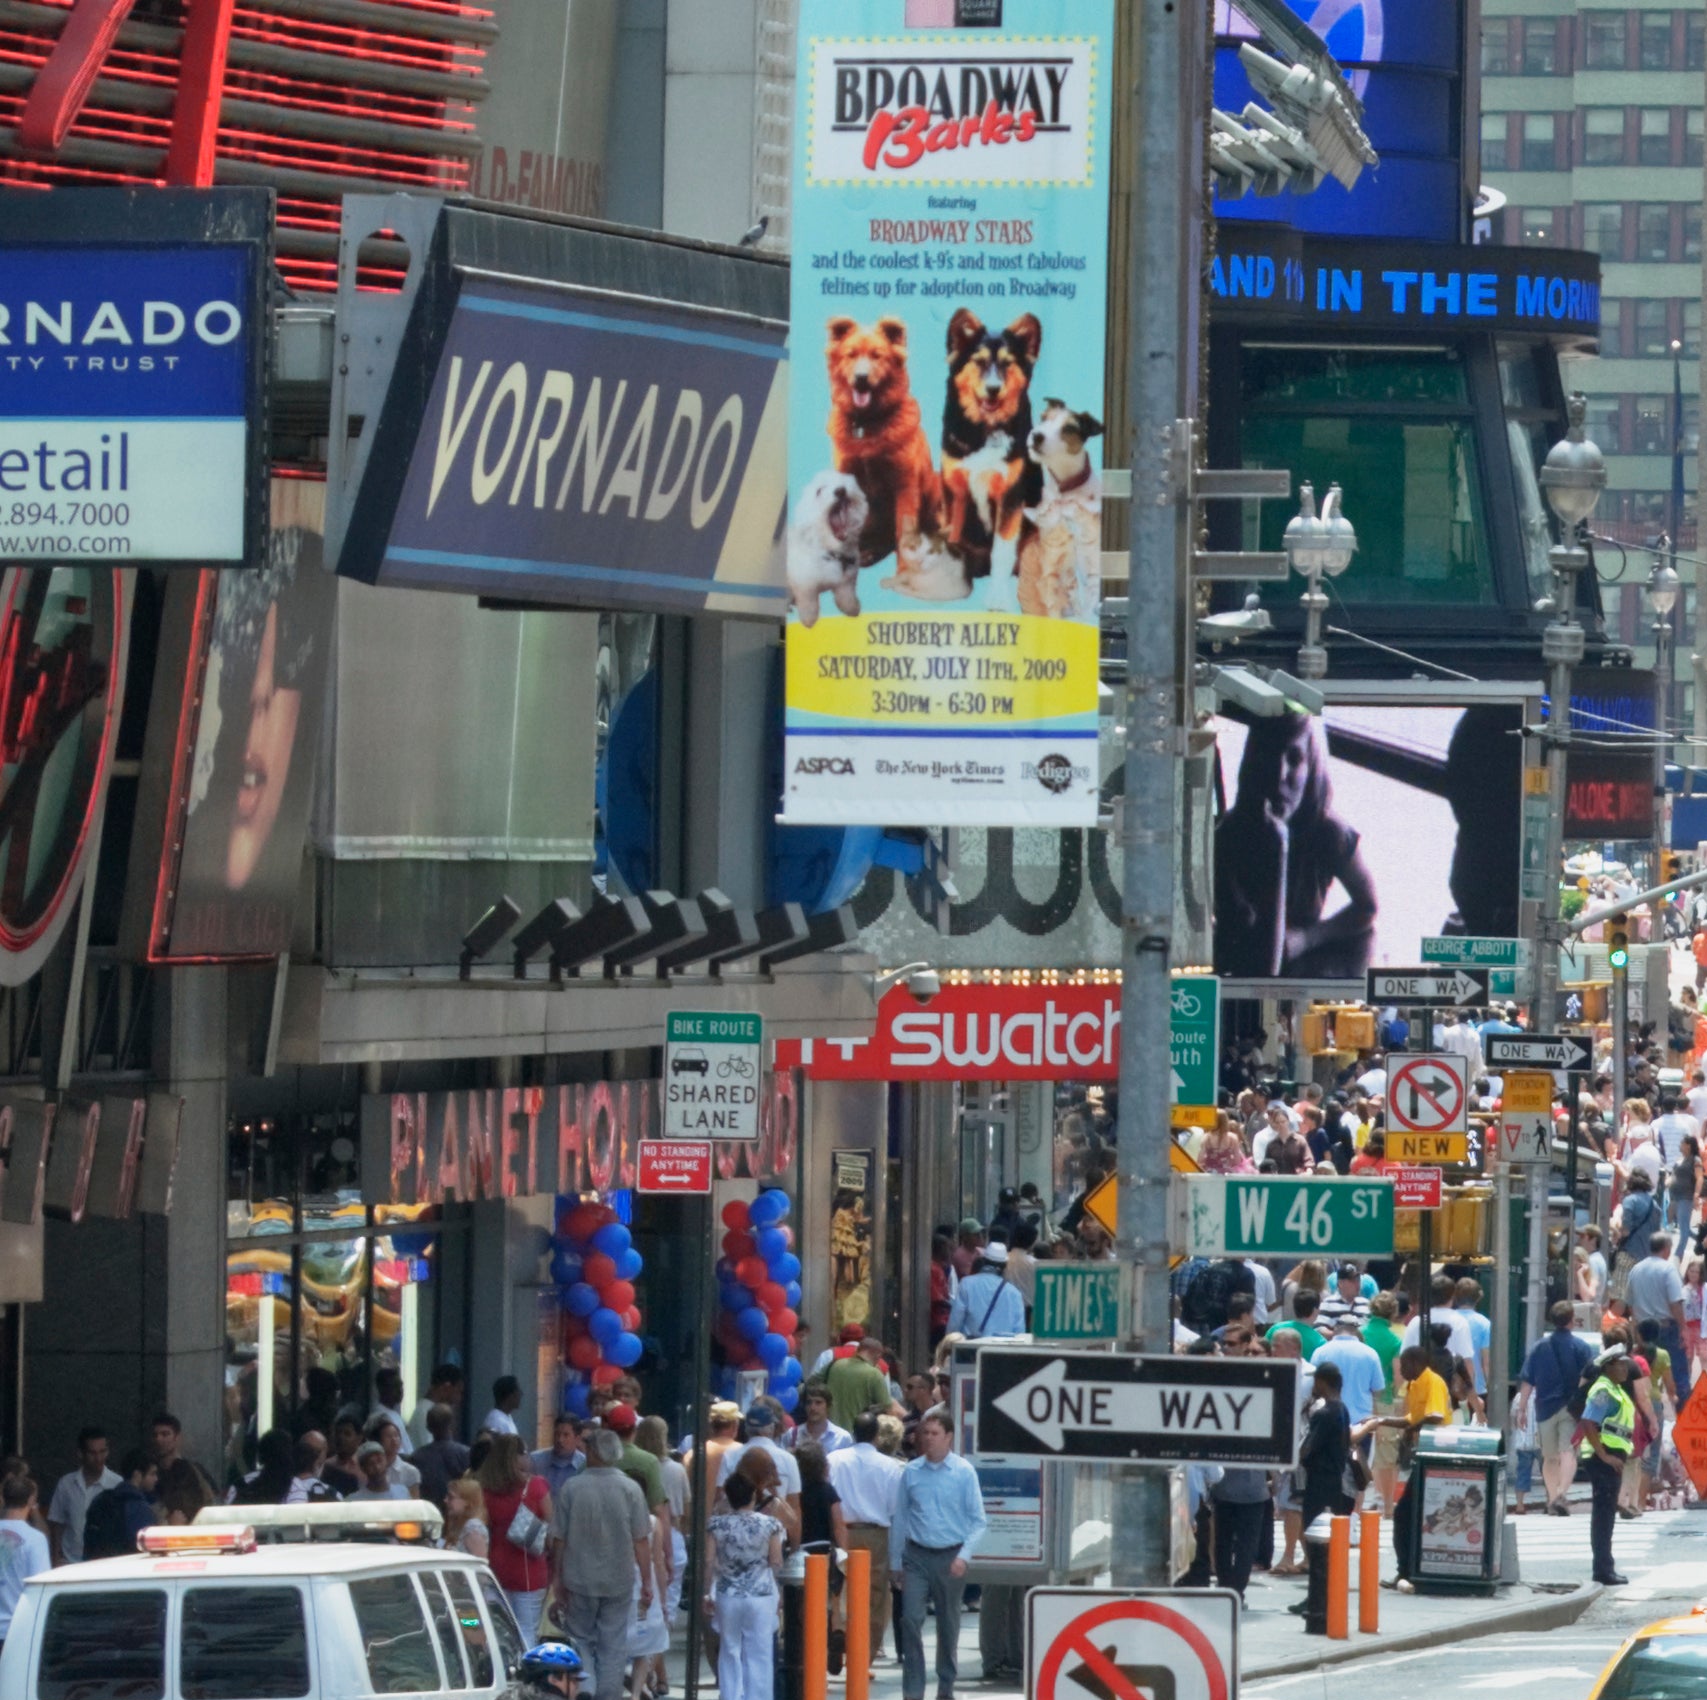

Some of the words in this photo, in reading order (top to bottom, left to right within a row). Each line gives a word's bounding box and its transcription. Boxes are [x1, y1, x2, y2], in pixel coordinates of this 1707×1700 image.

[835, 66, 1069, 124] BROADWAY
[862, 100, 1038, 171] Barks
[927, 196, 977, 211] featuring
[869, 219, 970, 244] BROADWAY
[974, 220, 1034, 244] STARS
[812, 252, 838, 269] and
[842, 252, 865, 269] the
[869, 252, 920, 270] coolest
[958, 252, 984, 270] and
[988, 253, 1024, 270] most
[1027, 252, 1087, 271] fabulous
[821, 278, 870, 296] felines
[873, 282, 892, 299] up
[895, 279, 916, 296] for
[920, 278, 984, 298] adoption
[987, 282, 1005, 297] on
[1010, 279, 1077, 300] Broadway
[1208, 254, 1275, 298] AND
[1317, 267, 1362, 312] IN
[1382, 270, 1498, 316] THE
[64, 356, 179, 370] TRUST
[427, 354, 744, 531] VORNADO
[866, 621, 956, 648] SHUBERT
[960, 622, 1021, 648] ALLEY
[818, 656, 918, 682] SATURDAY,
[922, 656, 971, 680] JULY
[1023, 658, 1068, 680] 2009
[871, 691, 930, 714] 3:30PM
[948, 691, 987, 714] 6:30
[991, 695, 1014, 714] PM
[794, 757, 855, 775] ASPCA
[875, 759, 900, 774] The
[901, 761, 928, 774] New
[931, 760, 963, 778] York
[964, 760, 1004, 775] Times
[1021, 760, 1091, 782] Pedigree
[1424, 940, 1467, 958] GEORGE
[1471, 940, 1513, 957] ABBOTT
[1384, 978, 1418, 995] ONE
[1436, 979, 1471, 996] WAY
[672, 1020, 703, 1035] BIKE
[709, 1020, 755, 1036] ROUTE
[890, 1000, 1121, 1066] swatch
[1499, 1042, 1529, 1058] ONE
[1545, 1046, 1576, 1061] WAY
[668, 1084, 756, 1104] SHARED
[682, 1110, 740, 1129] LANE
[390, 1087, 543, 1203] PLANET
[1402, 1138, 1451, 1157] NEW
[1521, 1134, 1532, 1143] TO
[643, 1146, 658, 1157] NO
[661, 1146, 707, 1158] STANDING
[650, 1160, 699, 1171] ANYTIME
[840, 1175, 864, 1187] 2009
[1401, 1171, 1438, 1181] STANDING
[1394, 1183, 1433, 1192] ANYTIME
[1238, 1187, 1268, 1245] W
[1285, 1189, 1333, 1246] 46
[1351, 1188, 1382, 1219] ST
[1041, 1273, 1104, 1333] TIMES
[1027, 1385, 1112, 1426] ONE
[1159, 1389, 1254, 1431] WAY
